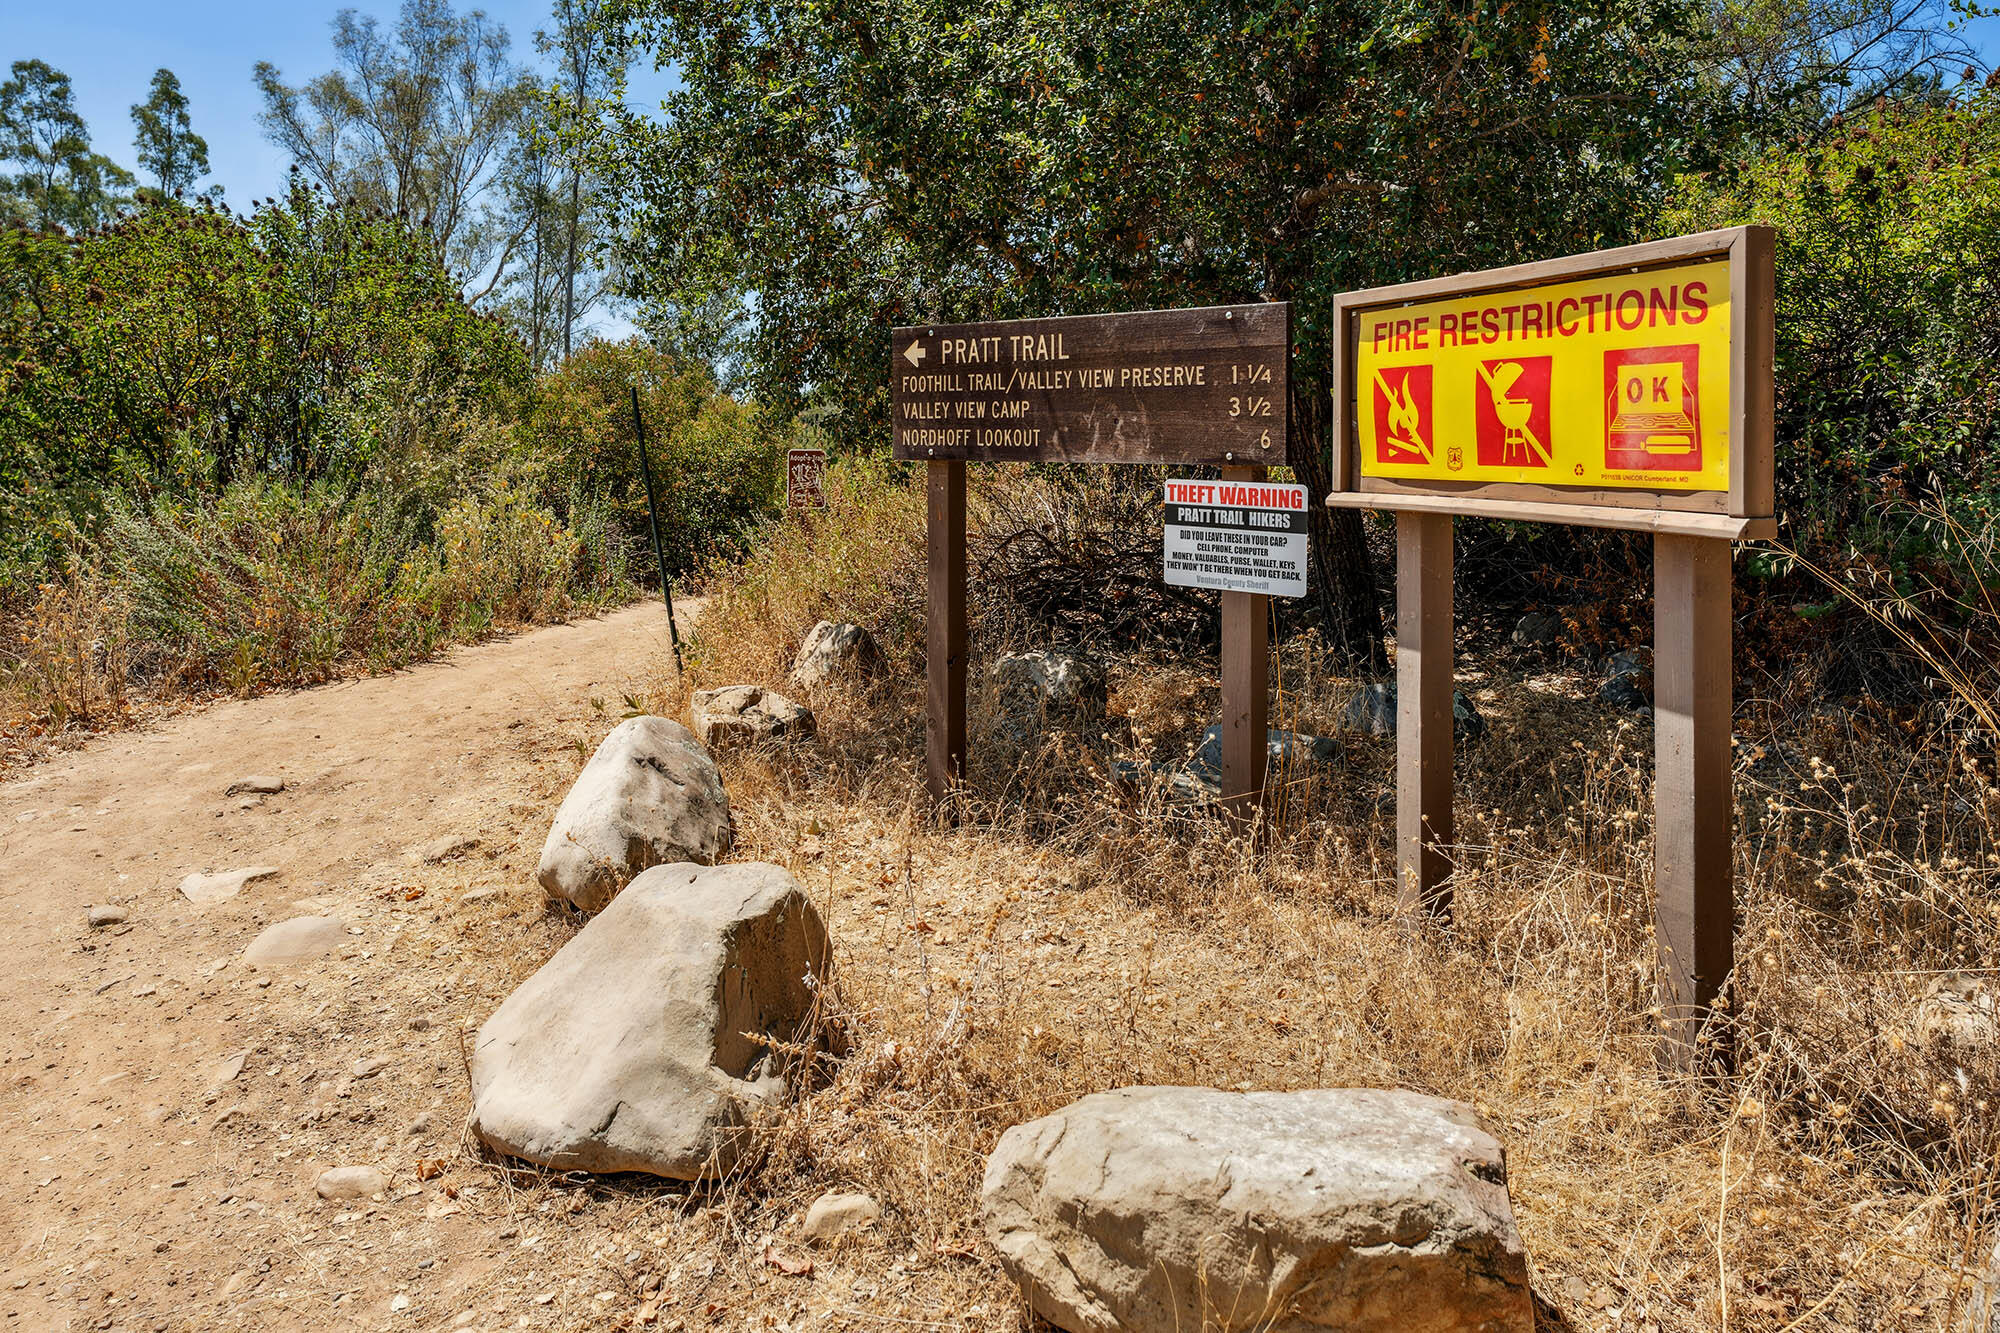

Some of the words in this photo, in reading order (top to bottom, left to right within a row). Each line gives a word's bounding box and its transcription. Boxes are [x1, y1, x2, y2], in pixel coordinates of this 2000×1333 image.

[1373, 316, 1429, 354] FIRE
[1440, 281, 1708, 348] RESTRICTIONS
[942, 337, 1001, 365] PRATT
[1010, 333, 1070, 362] TRAIL
[902, 374, 963, 393] FOOTHILL
[968, 368, 1072, 394] TRAIL/VALLEY
[1079, 369, 1114, 388] VIEW
[1121, 365, 1205, 387] PRESERVE
[1231, 365, 1238, 385] 1
[902, 402, 950, 419] VALLEY
[954, 401, 986, 419] VIEW
[991, 400, 1030, 419] CAMP
[1228, 397, 1241, 417] 3
[902, 429, 971, 447] NORDHOFF
[976, 429, 1041, 447] LOOKOUT
[1260, 429, 1271, 449] 6
[1167, 484, 1215, 504] THEFT
[1219, 486, 1303, 509] WARNING
[1177, 507, 1212, 523] PRATT
[1213, 509, 1245, 525] TRAIL
[1249, 511, 1291, 529] HIKERS
[1180, 530, 1191, 540] DID
[1192, 530, 1204, 541] YOU
[1205, 531, 1222, 542] LEAVE
[1223, 532, 1242, 544] THESE
[1243, 534, 1250, 545] IN
[1251, 534, 1268, 546] YOUR
[1269, 536, 1288, 547] CAR?
[1197, 543, 1210, 552] CELL
[1234, 546, 1269, 556] COMPUTER
[1167, 561, 1181, 570] THEY
[1204, 564, 1212, 573] BE
[1213, 565, 1233, 574] THERE
[1233, 567, 1252, 576] WHEN
[1253, 568, 1267, 578] YOU
[1268, 569, 1281, 579] GET
[1281, 571, 1302, 581] BACK.
[1172, 551, 1194, 562] MONEY,
[1194, 553, 1229, 565] VALUABLES,
[1252, 558, 1278, 569] WALLET,
[1279, 560, 1296, 570] KEYS
[1196, 575, 1222, 585] Ventura
[1222, 578, 1245, 588] County
[1246, 580, 1269, 590] Sheriff
